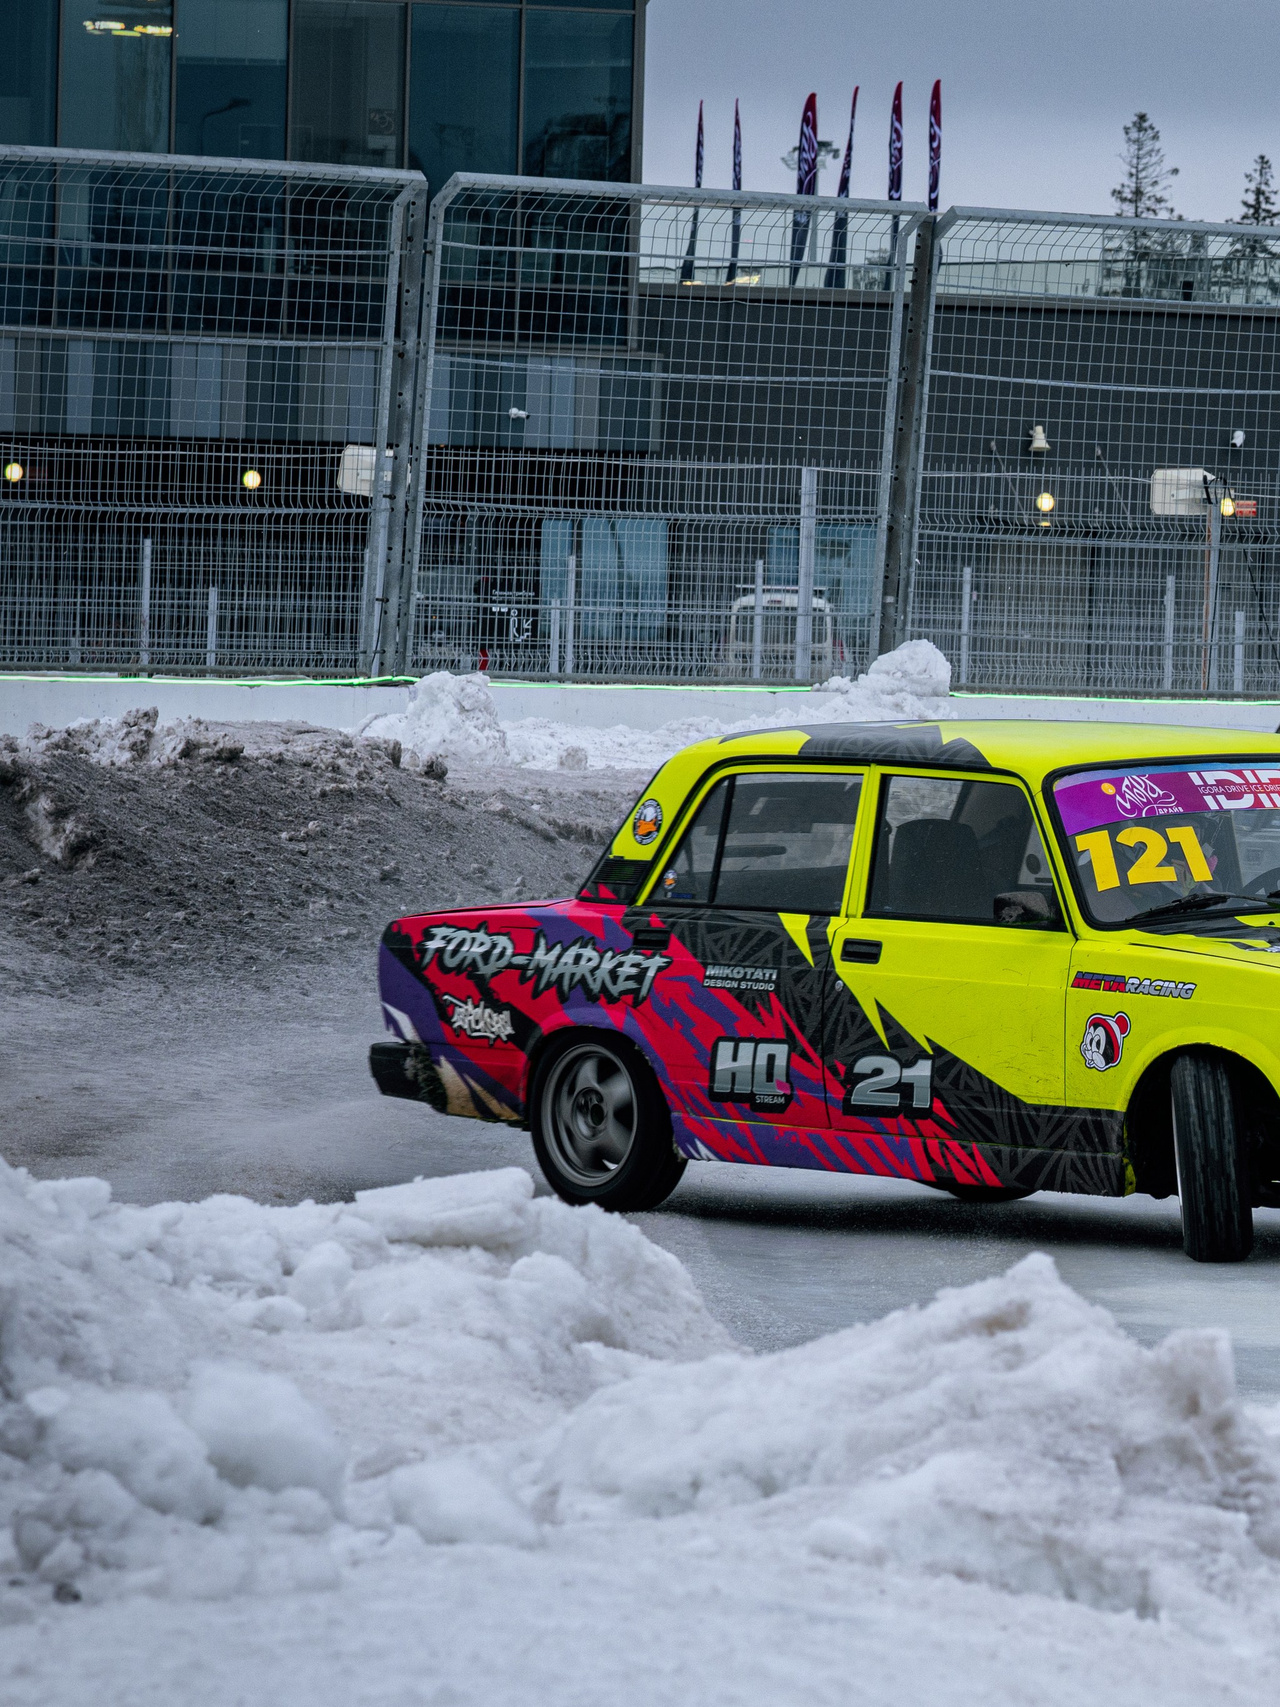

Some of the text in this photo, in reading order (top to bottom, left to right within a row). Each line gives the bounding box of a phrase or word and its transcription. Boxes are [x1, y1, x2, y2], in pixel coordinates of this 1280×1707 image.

[1198, 785, 1226, 794] IGORA
[1226, 784, 1250, 793] DRIVE
[1250, 784, 1264, 792] ICE
[1075, 826, 1213, 892] 121
[705, 964, 777, 981] MIKOTATI
[703, 978, 775, 991] DESIGN STUDIO
[713, 1041, 791, 1096] HQ
[850, 1055, 933, 1108] 21
[755, 1095, 785, 1104] STREAM
